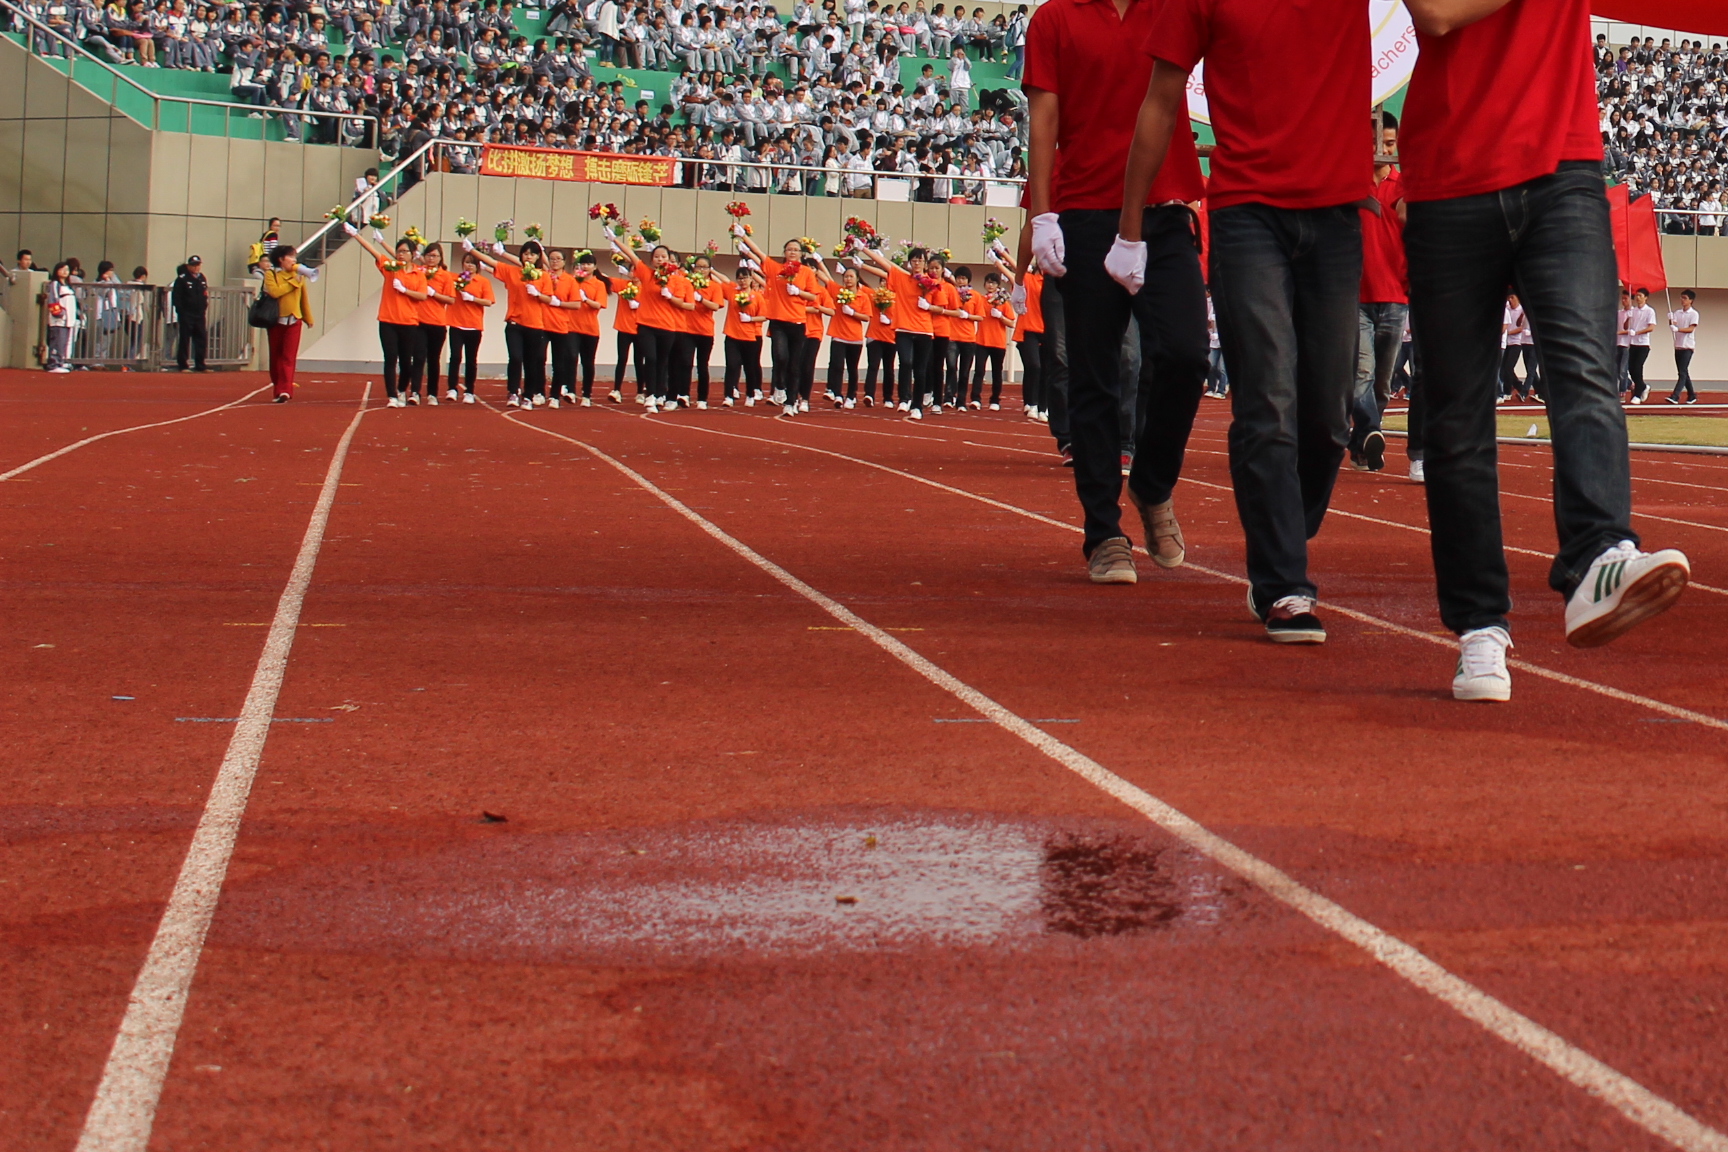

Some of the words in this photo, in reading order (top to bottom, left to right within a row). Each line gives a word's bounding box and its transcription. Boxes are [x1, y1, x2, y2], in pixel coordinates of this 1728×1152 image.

[1371, 25, 1416, 79] achers
[488, 148, 574, 179] 比拼激扬梦想
